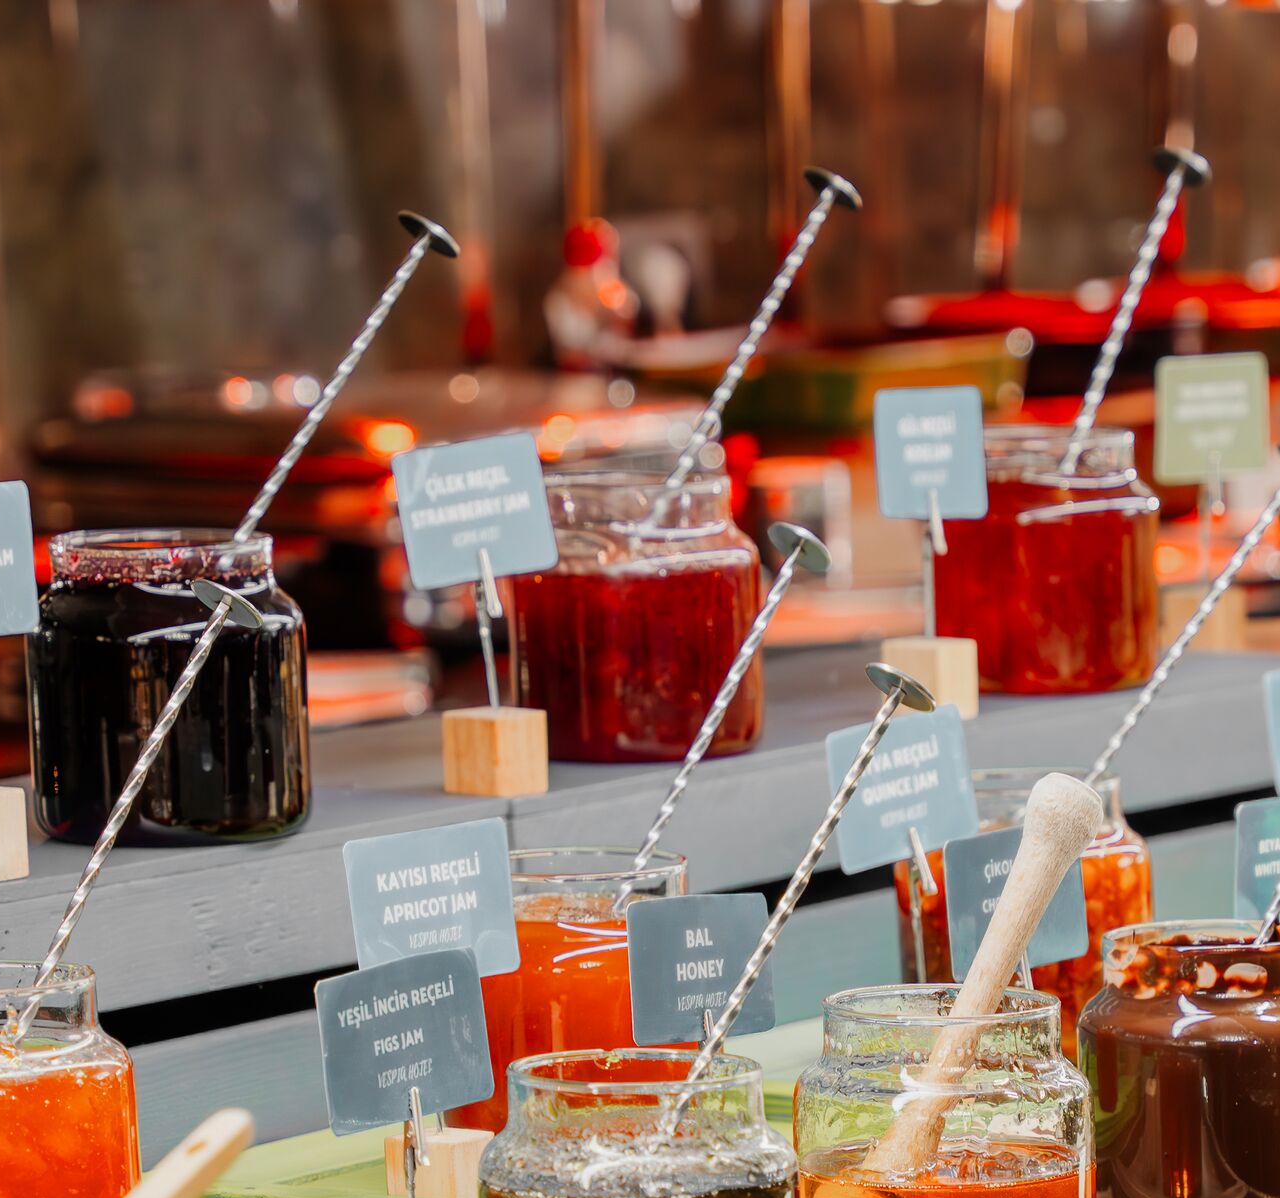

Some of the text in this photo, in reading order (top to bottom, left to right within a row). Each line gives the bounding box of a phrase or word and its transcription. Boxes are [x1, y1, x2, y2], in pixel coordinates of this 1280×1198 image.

[410, 491, 530, 529] STRAWBERRY JAM
[862, 769, 938, 806] QUINCE JAM
[377, 851, 480, 893] KAYISI REÇELİ
[1255, 860, 1280, 877] WHITE
[383, 890, 477, 925] APRICOT JAM
[686, 928, 713, 948] BAL
[677, 959, 724, 981] HONEY
[338, 975, 454, 1029] YEŞİL İNCİR REÇELİ
[374, 1028, 424, 1056] FIGS JAM
